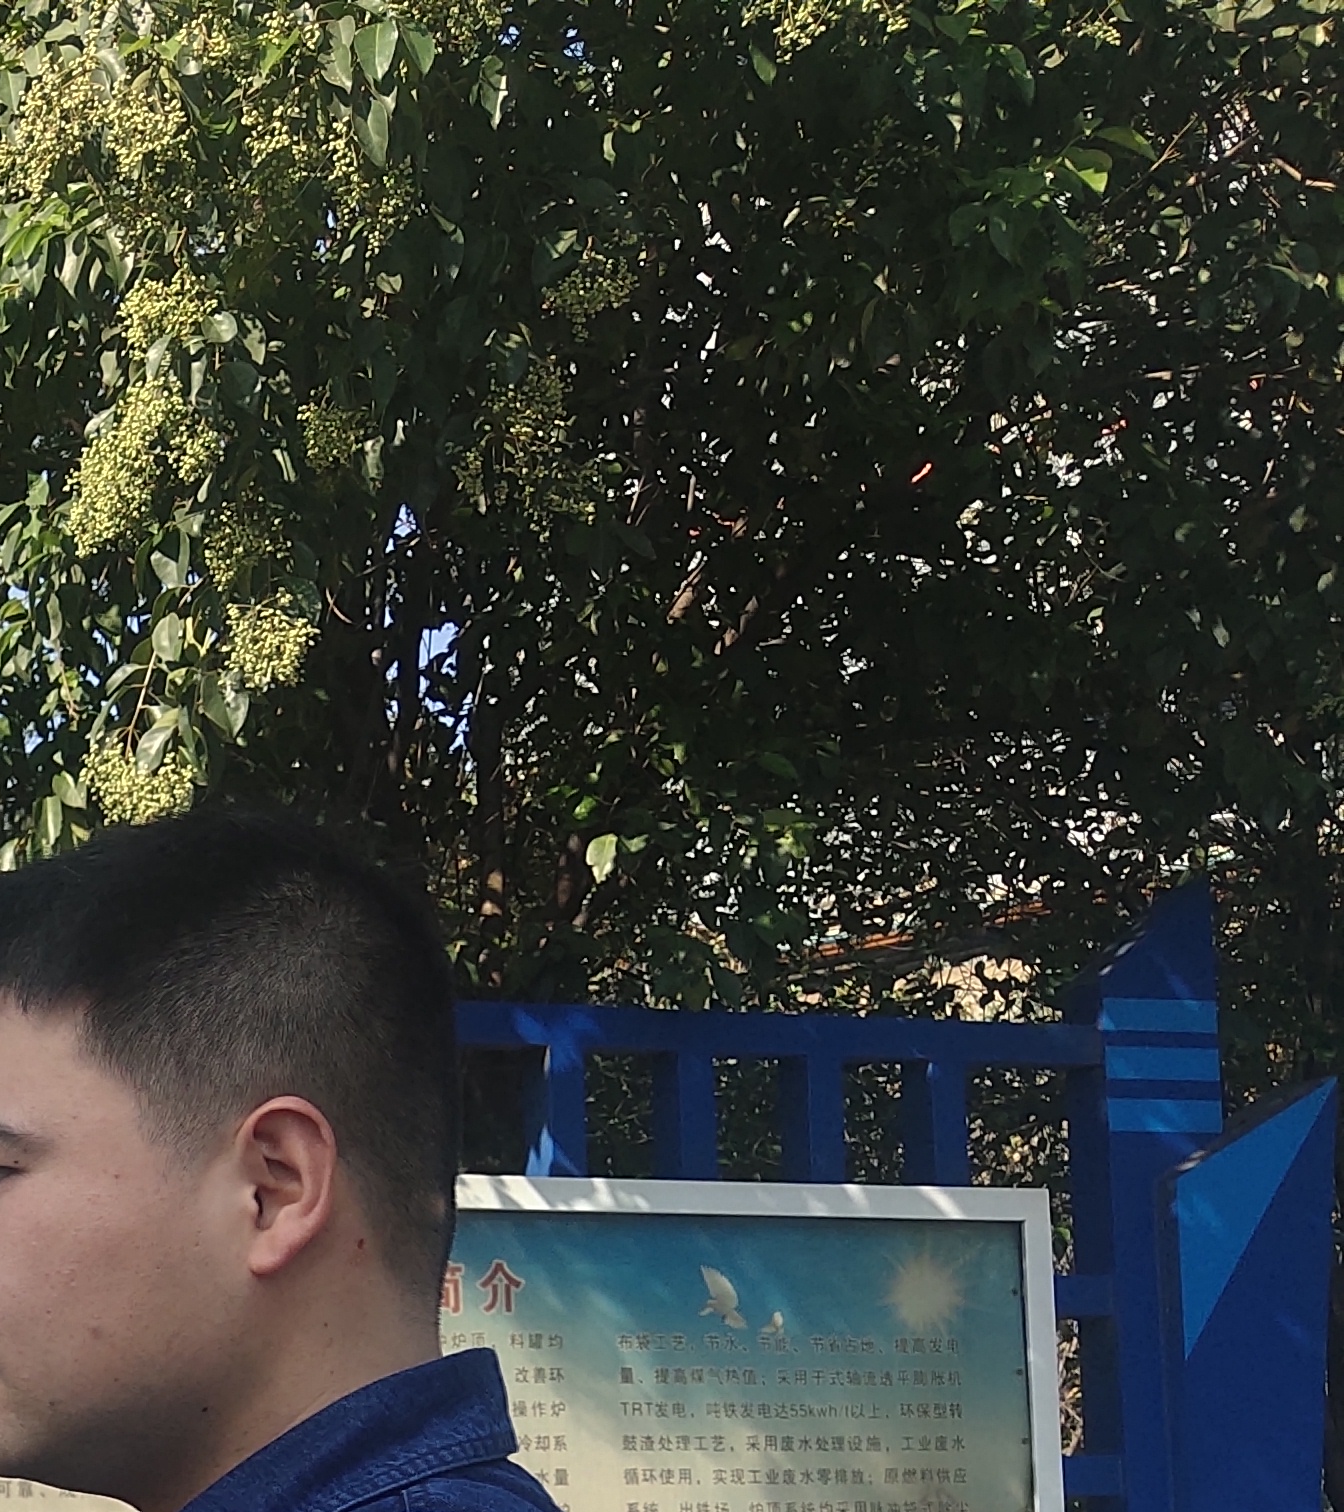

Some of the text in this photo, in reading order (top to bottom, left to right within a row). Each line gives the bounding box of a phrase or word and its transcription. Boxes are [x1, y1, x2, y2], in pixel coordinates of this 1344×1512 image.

[515, 1366, 565, 1384] 改善环
[512, 1401, 566, 1418] 操作炉
[518, 1435, 568, 1451] 冷却系
